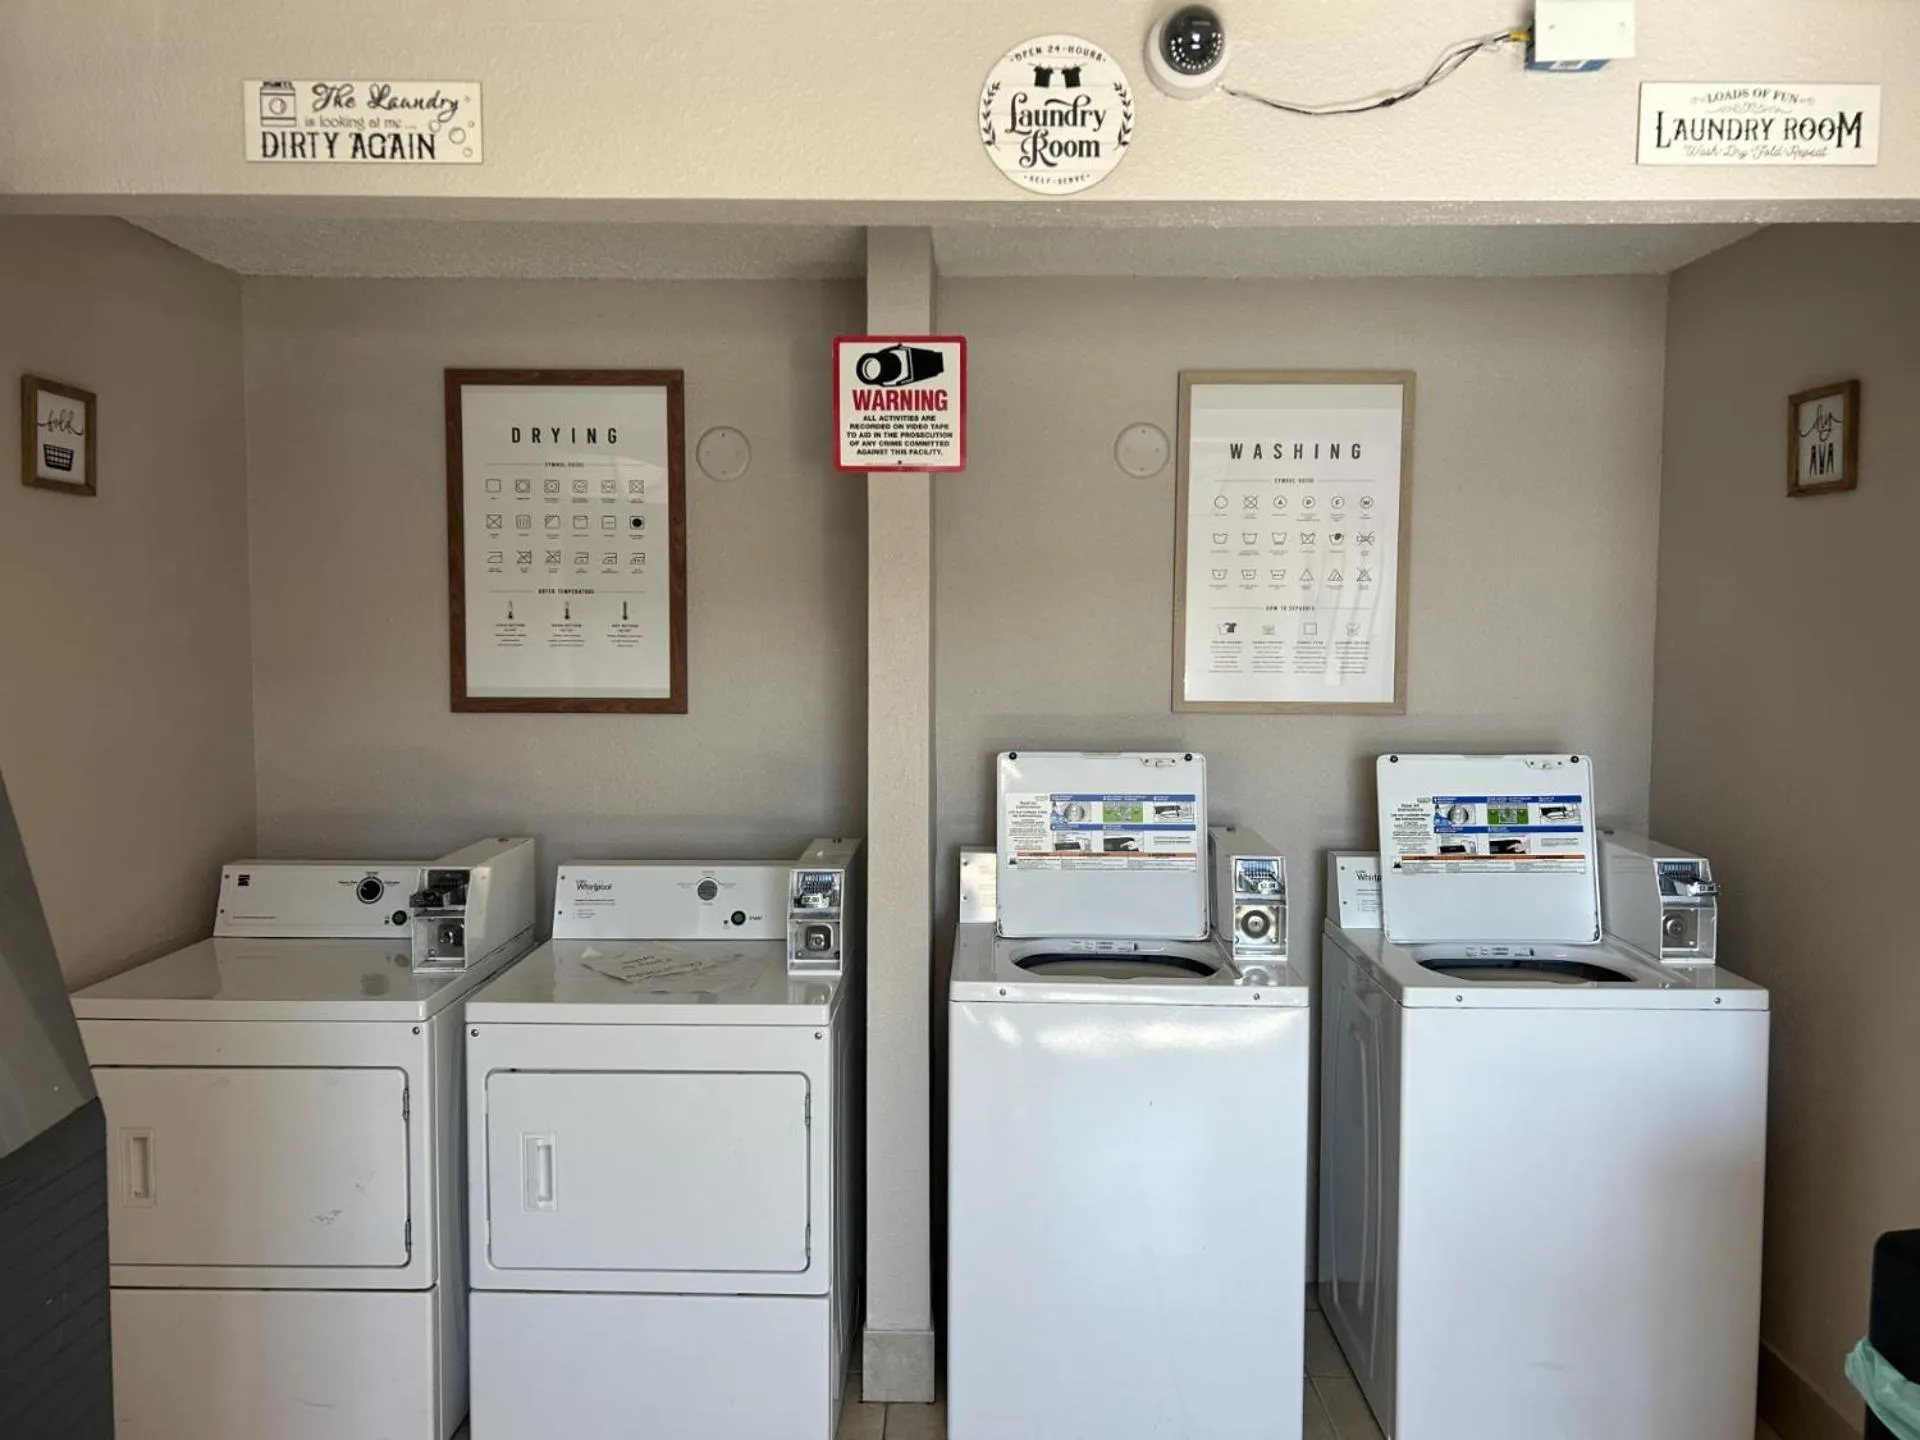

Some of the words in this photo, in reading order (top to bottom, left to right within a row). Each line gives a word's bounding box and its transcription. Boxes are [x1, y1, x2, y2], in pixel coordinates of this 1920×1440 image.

[1015, 46, 1042, 61] OPEN
[311, 82, 357, 113] The
[366, 83, 459, 123] Laundry
[1707, 89, 1750, 104] LOADS
[1752, 87, 1769, 98] OF
[1773, 90, 1800, 104] FUN
[304, 116, 316, 127] is
[319, 115, 366, 131] looking
[368, 116, 381, 128] at
[1004, 92, 1107, 136] Laundry
[1656, 111, 1775, 148] LAUNDRY
[1783, 111, 1864, 148] ROOM
[261, 131, 340, 159] DIRTY
[349, 132, 437, 160] AGAIN
[1018, 128, 1100, 169] Room
[1684, 145, 1718, 157] Wash
[852, 389, 949, 412] WARNING
[511, 427, 618, 444] DRYING
[1229, 443, 1362, 460] WASHING
